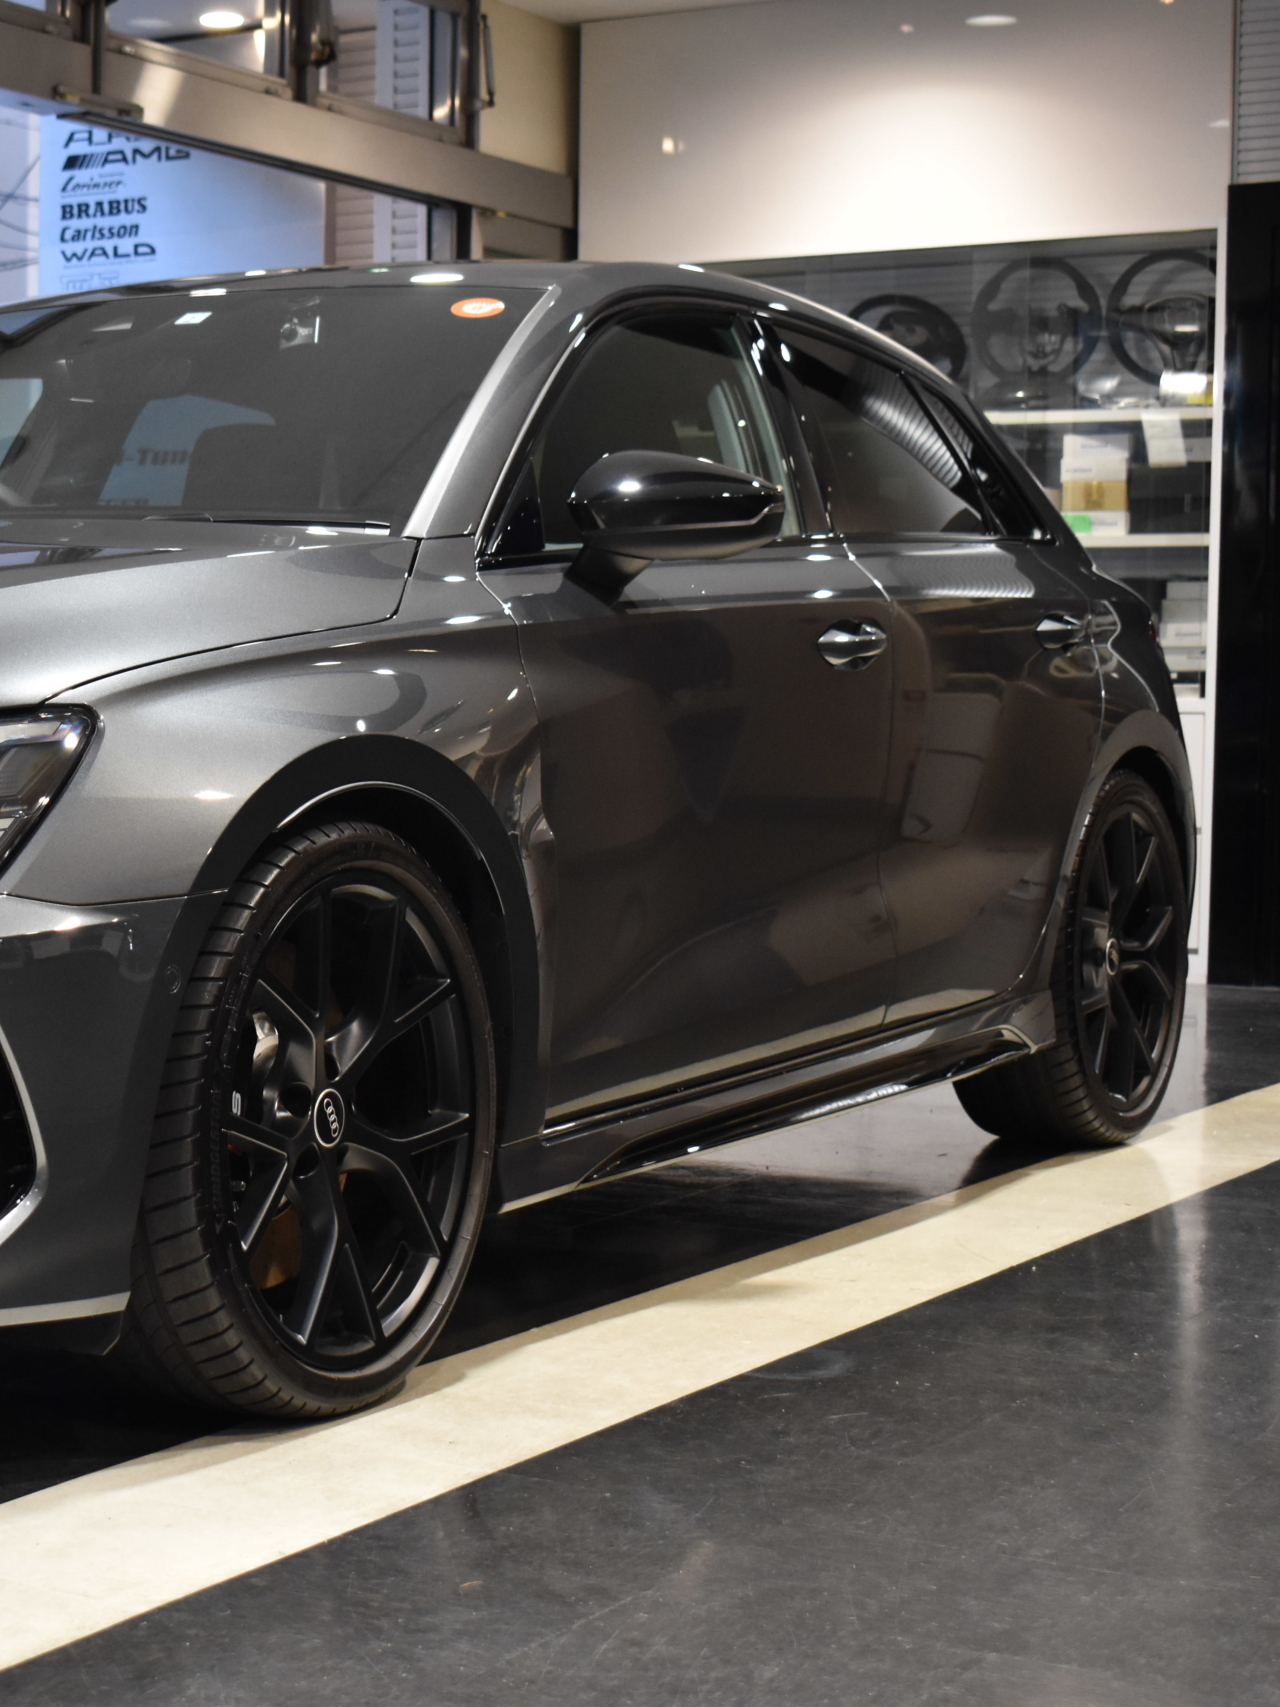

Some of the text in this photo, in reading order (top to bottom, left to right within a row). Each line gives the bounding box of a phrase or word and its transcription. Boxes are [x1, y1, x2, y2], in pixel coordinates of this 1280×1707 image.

[101, 145, 191, 168] AMG
[61, 197, 147, 221] BRABUS
[60, 223, 140, 243] Carlsson
[61, 243, 156, 263] WALD
